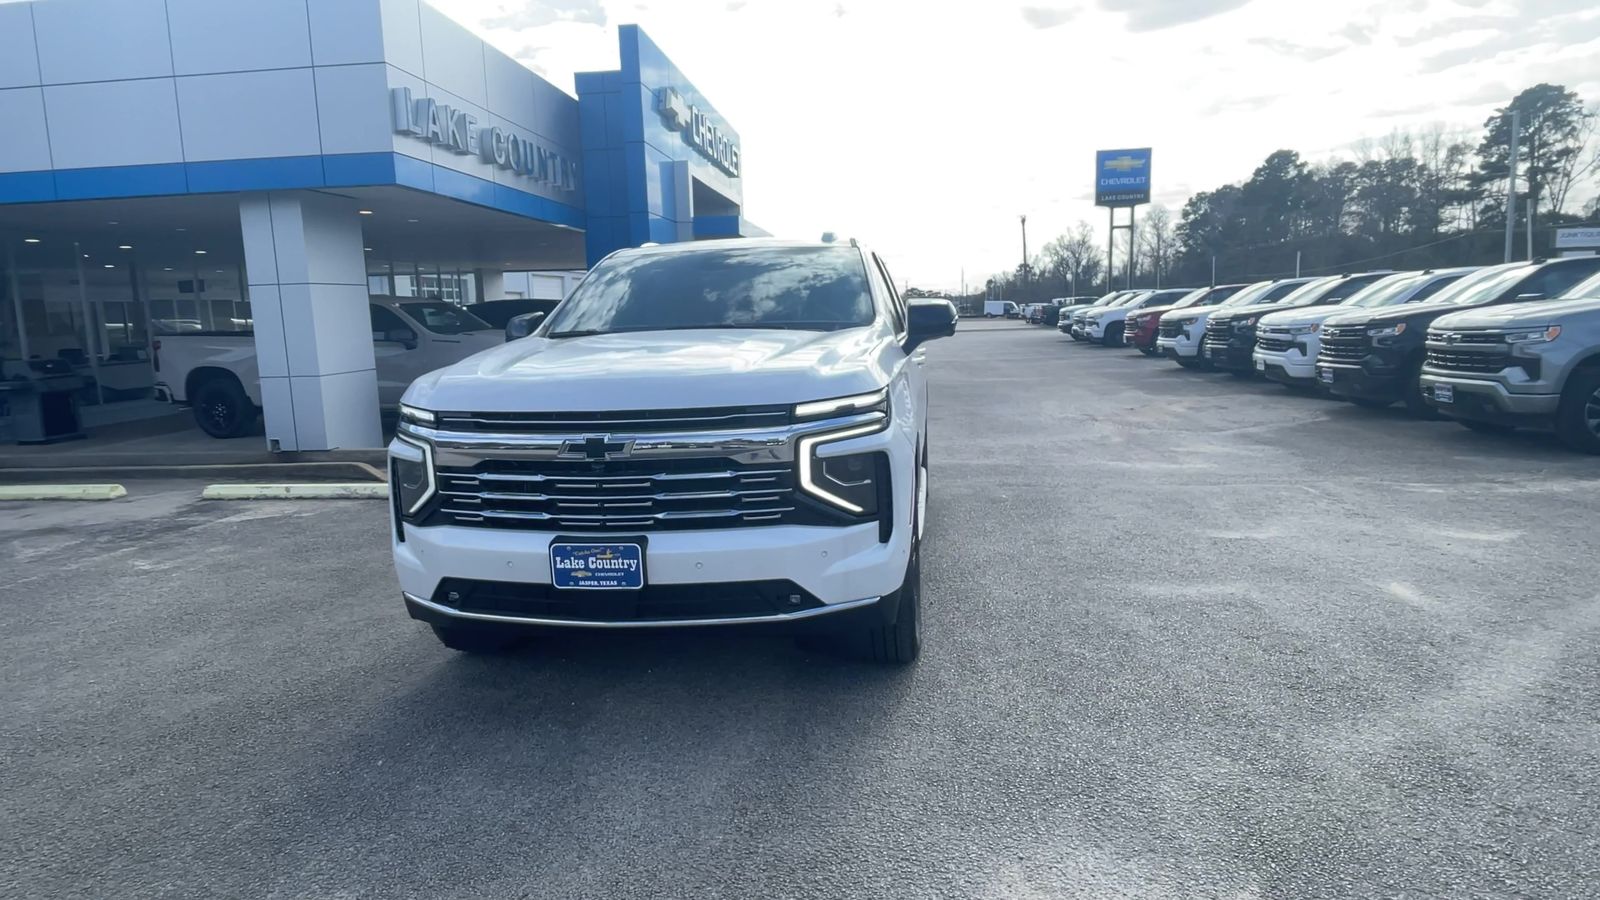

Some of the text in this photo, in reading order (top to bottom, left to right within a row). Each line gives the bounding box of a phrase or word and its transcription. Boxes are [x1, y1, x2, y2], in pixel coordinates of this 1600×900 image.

[390, 87, 577, 191] LAKE COUNTRY
[690, 104, 741, 178] CHEVROLET
[1101, 176, 1146, 185] CHEVROLET
[555, 557, 637, 571] Lake Country
